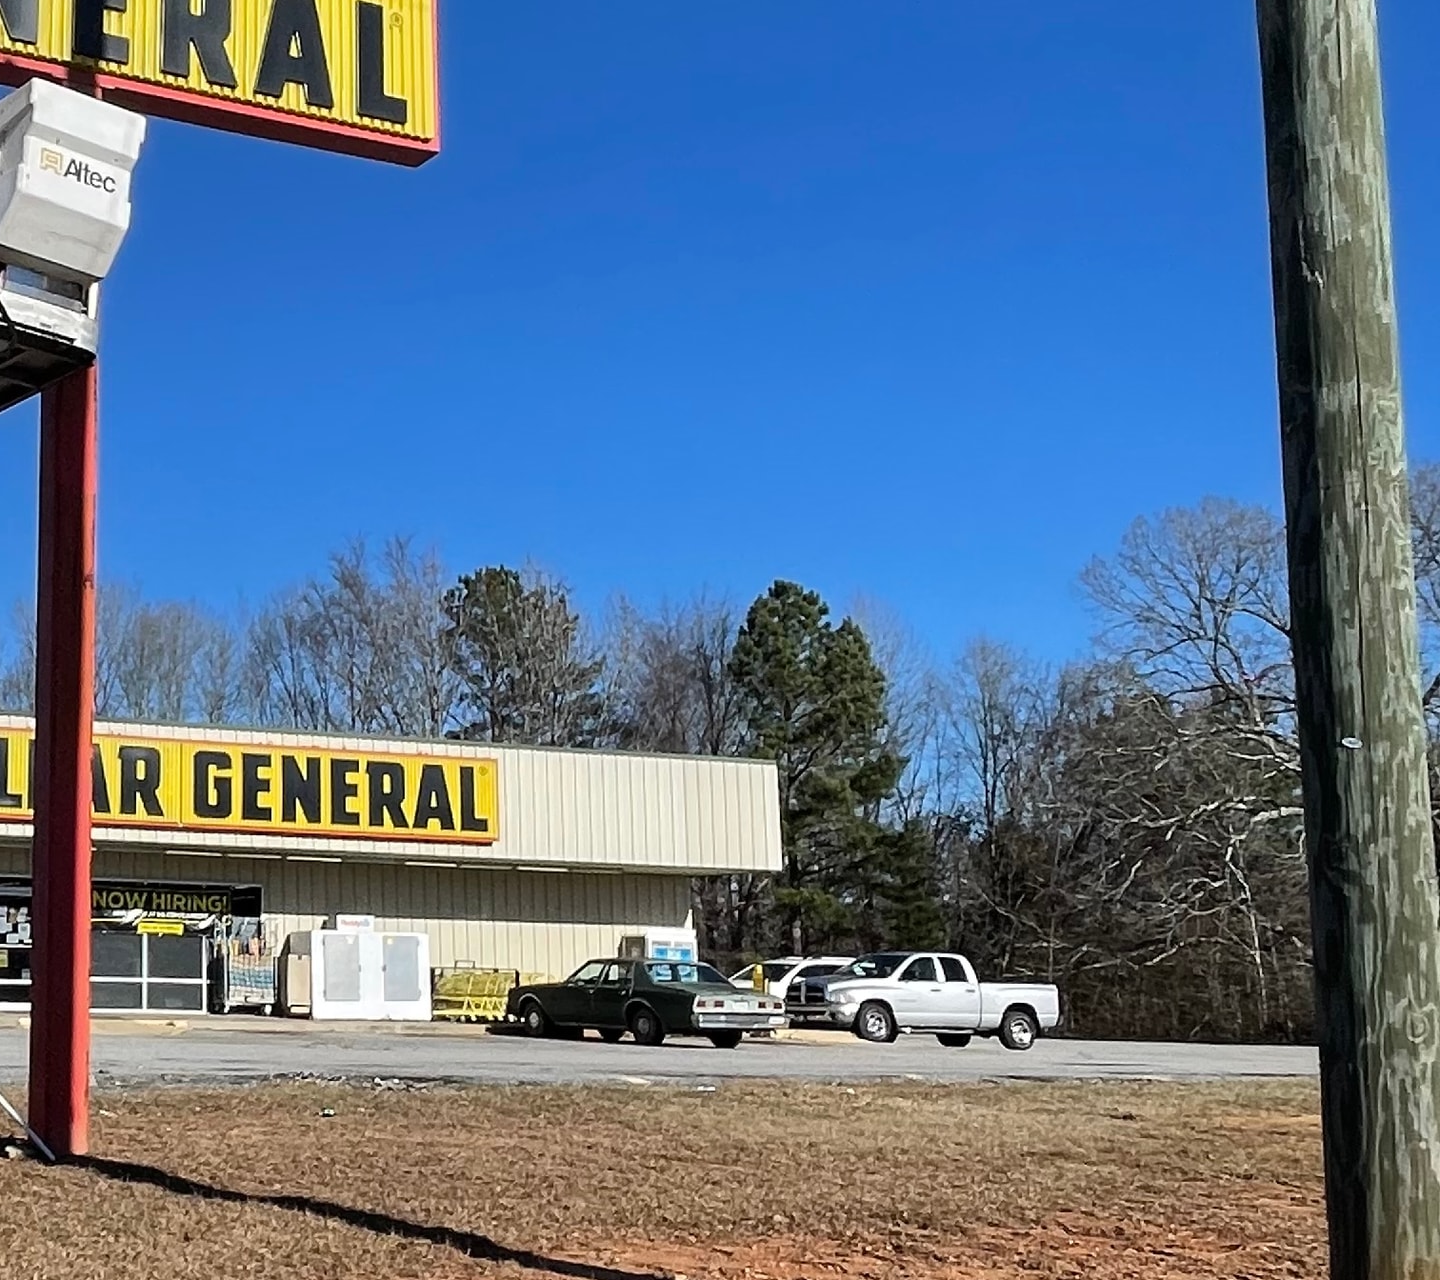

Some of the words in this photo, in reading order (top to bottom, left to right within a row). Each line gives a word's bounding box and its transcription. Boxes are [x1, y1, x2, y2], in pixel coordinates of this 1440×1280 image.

[64, 158, 116, 193] Altec
[193, 751, 488, 831] GENERAL
[92, 890, 147, 908] NOW
[154, 892, 227, 913] HIRING!
